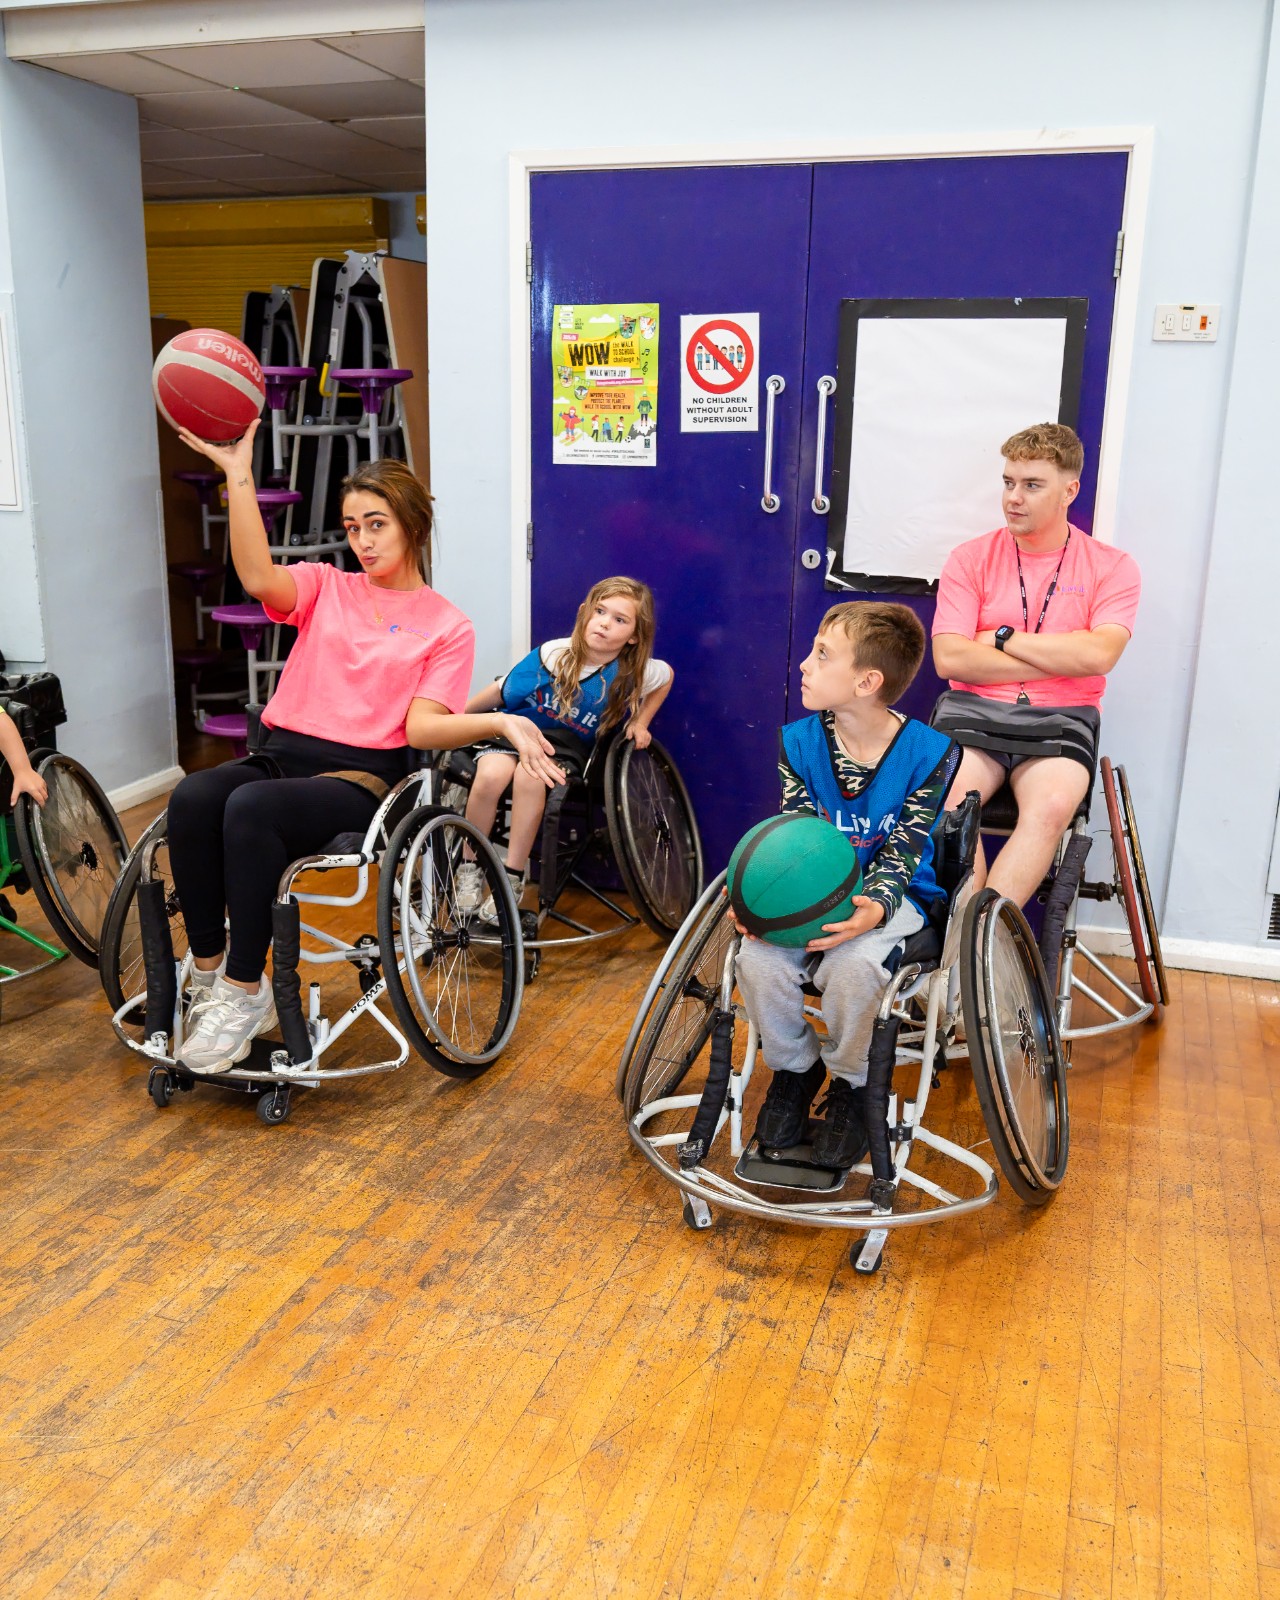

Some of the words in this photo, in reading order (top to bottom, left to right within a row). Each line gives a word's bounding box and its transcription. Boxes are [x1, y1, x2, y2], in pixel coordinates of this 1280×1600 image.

[197, 338, 262, 382] molten
[568, 342, 610, 367] WOW
[613, 356, 634, 364] challenge
[706, 396, 748, 404] CHILDREN
[686, 406, 724, 414] WITHOUT
[581, 711, 598, 728] it
[350, 983, 383, 1014] ROMA
